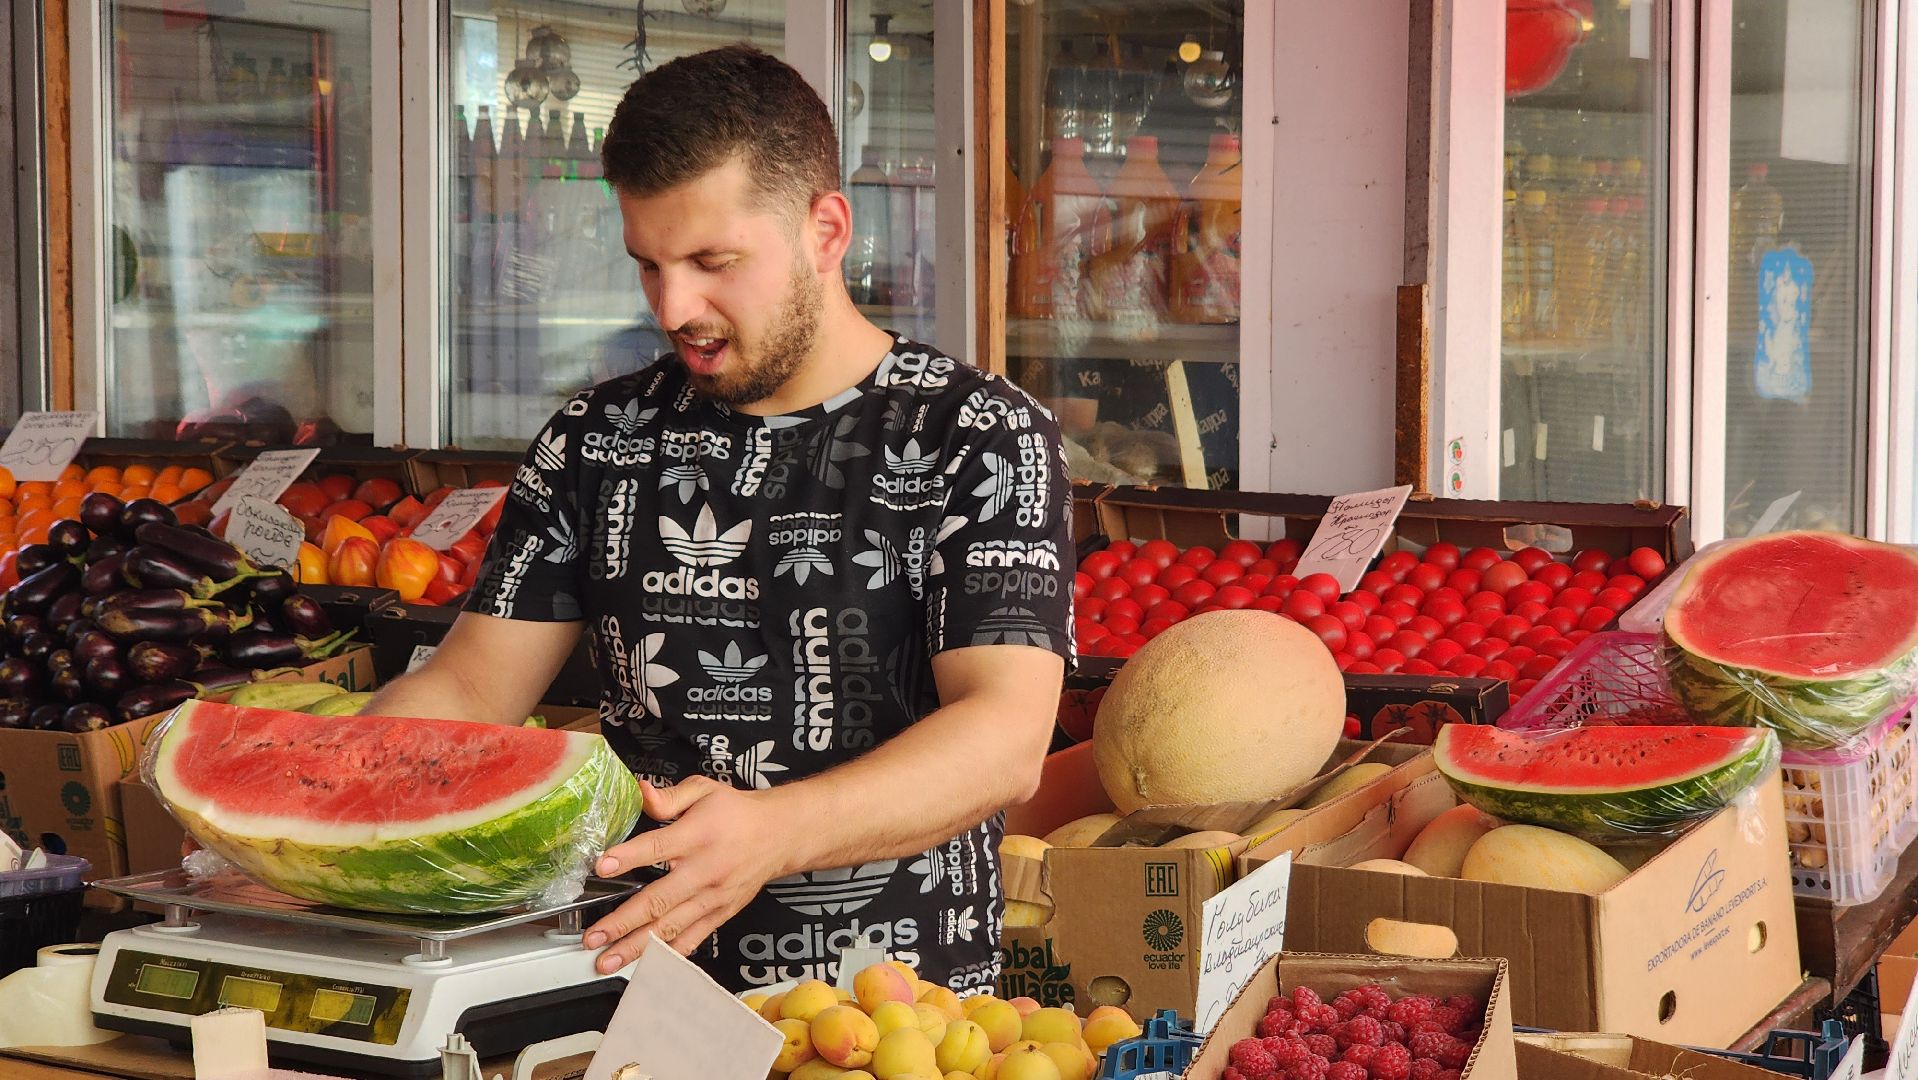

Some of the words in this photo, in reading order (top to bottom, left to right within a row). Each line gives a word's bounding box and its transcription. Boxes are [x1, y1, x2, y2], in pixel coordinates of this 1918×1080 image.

[1196, 409, 1228, 435] appa
[583, 431, 656, 453] adidas
[872, 473, 945, 494] adidas
[1015, 434, 1036, 527] adidas
[768, 528, 842, 546] adidas
[902, 526, 925, 601] adidas
[642, 566, 760, 600] adidas
[964, 570, 1058, 601] adidas
[686, 683, 773, 702] adidas
[835, 607, 884, 750] adidas
[1146, 865, 1178, 895] EAC
[738, 917, 920, 961] adidas
[946, 907, 956, 945] adidas
[1647, 933, 1692, 972] EXPORTADORA
[1700, 906, 1725, 933] BANANO
[1143, 953, 1185, 963] ecuador
[1148, 961, 1168, 970] love
[1169, 961, 1181, 970] life
[1001, 971, 1076, 1008] illage
